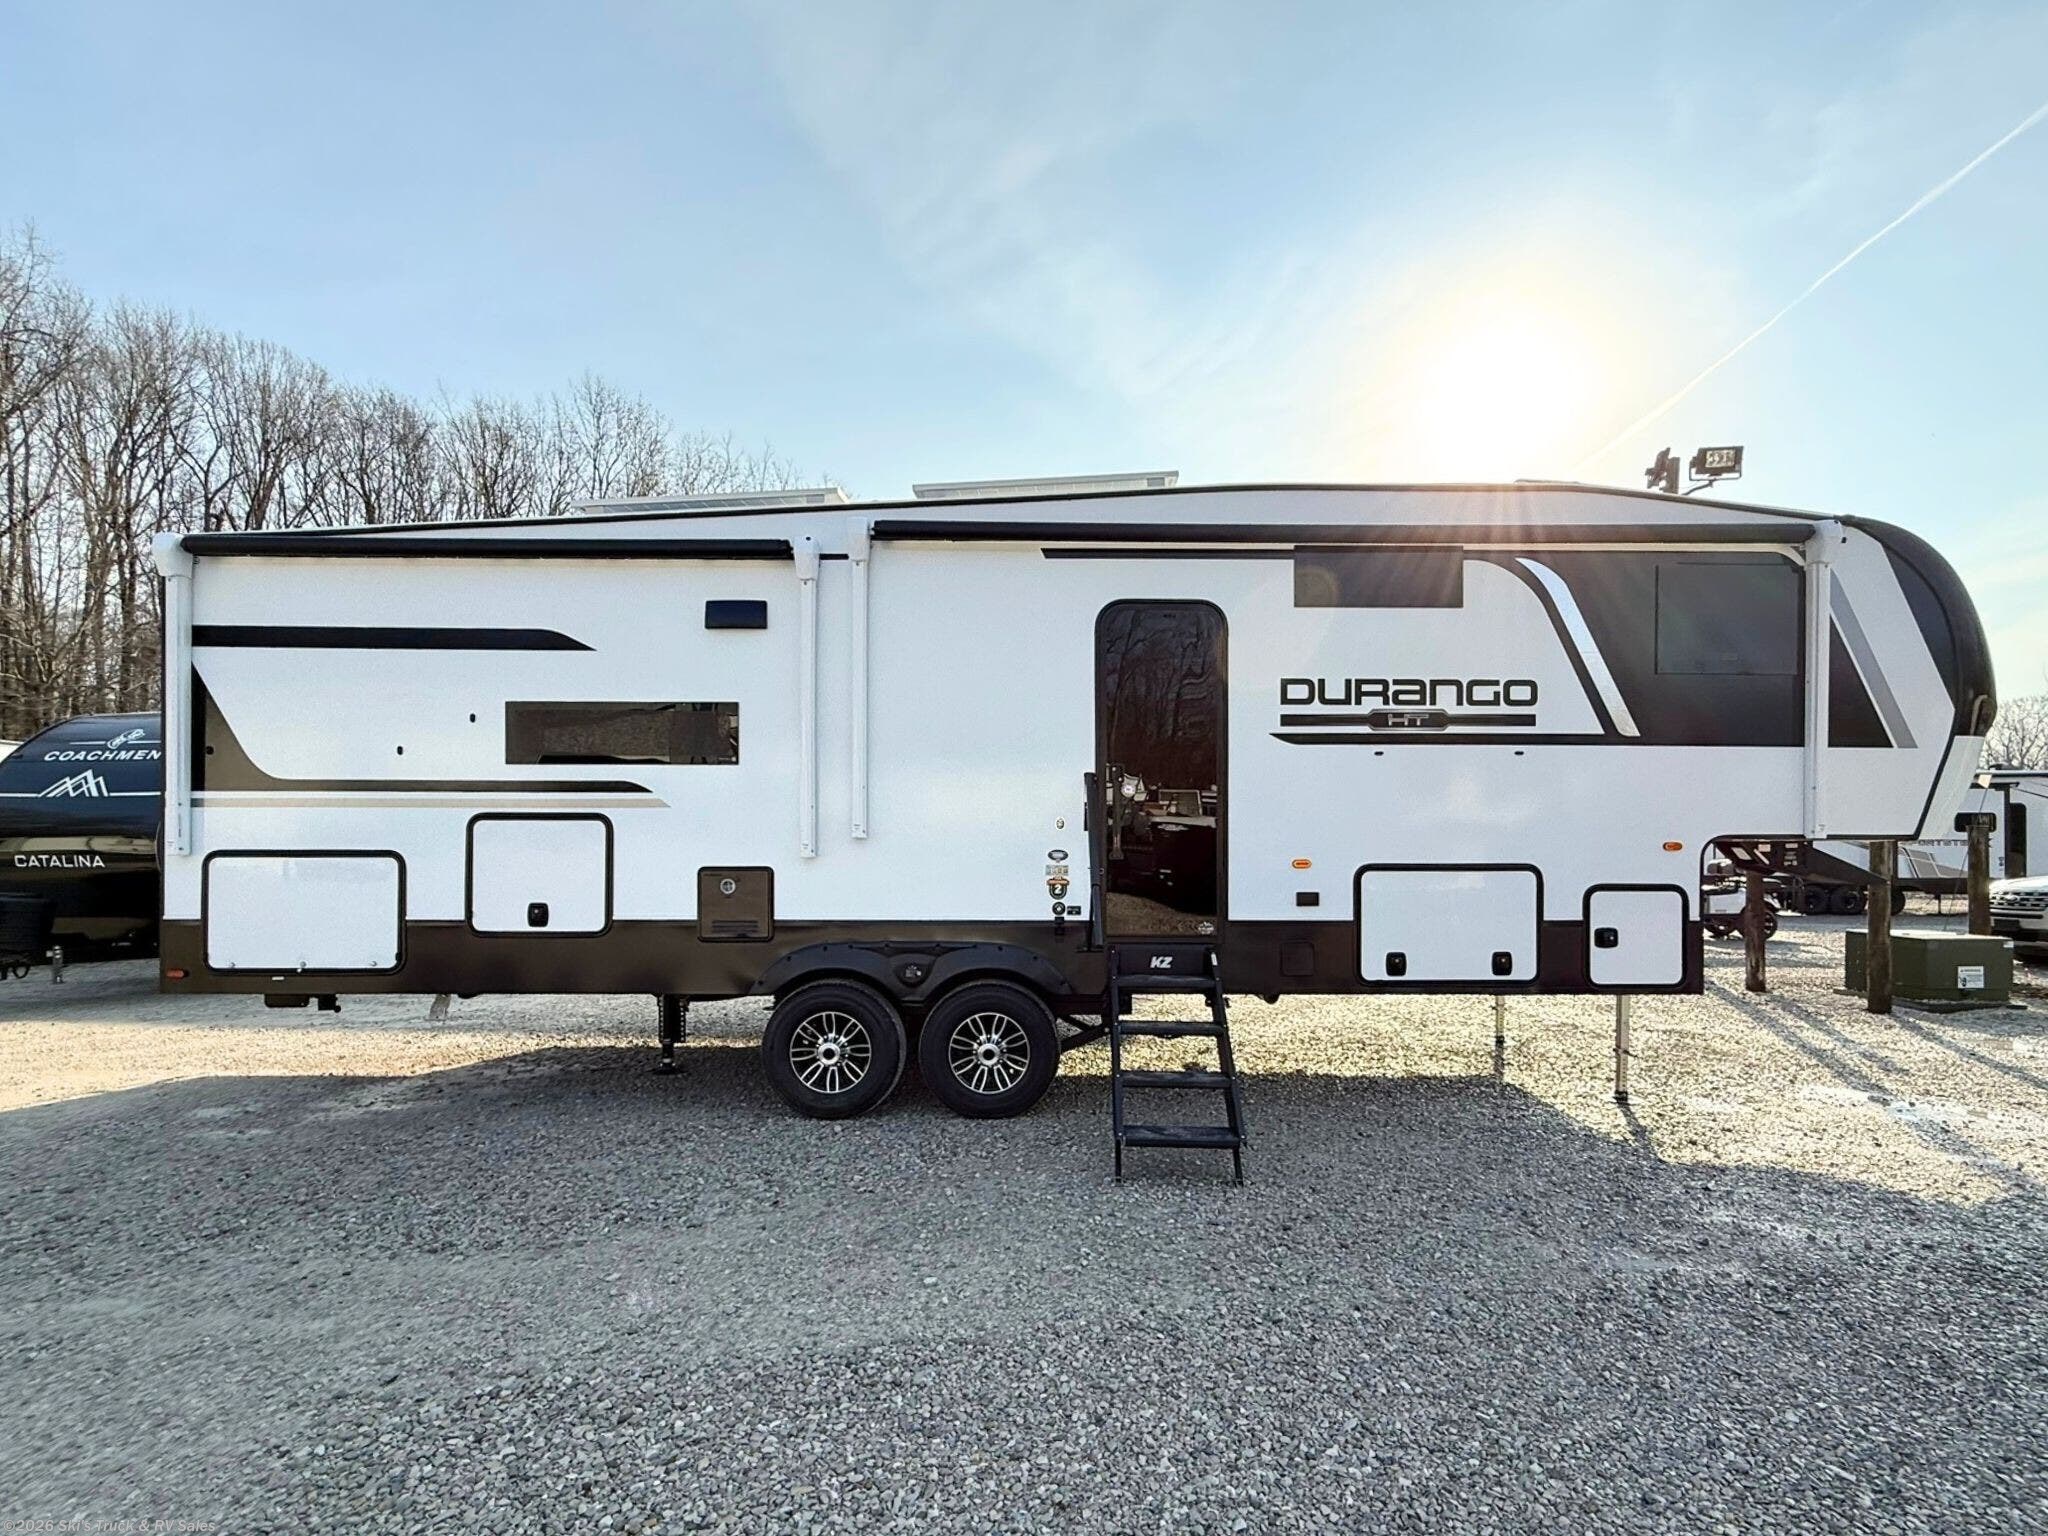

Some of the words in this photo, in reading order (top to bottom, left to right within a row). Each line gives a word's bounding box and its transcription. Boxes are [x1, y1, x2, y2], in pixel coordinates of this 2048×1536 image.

[1387, 713, 1430, 727] HT
[43, 750, 162, 762] COACHMEN
[14, 854, 106, 868] CATALINA
[1149, 956, 1174, 969] KZ
